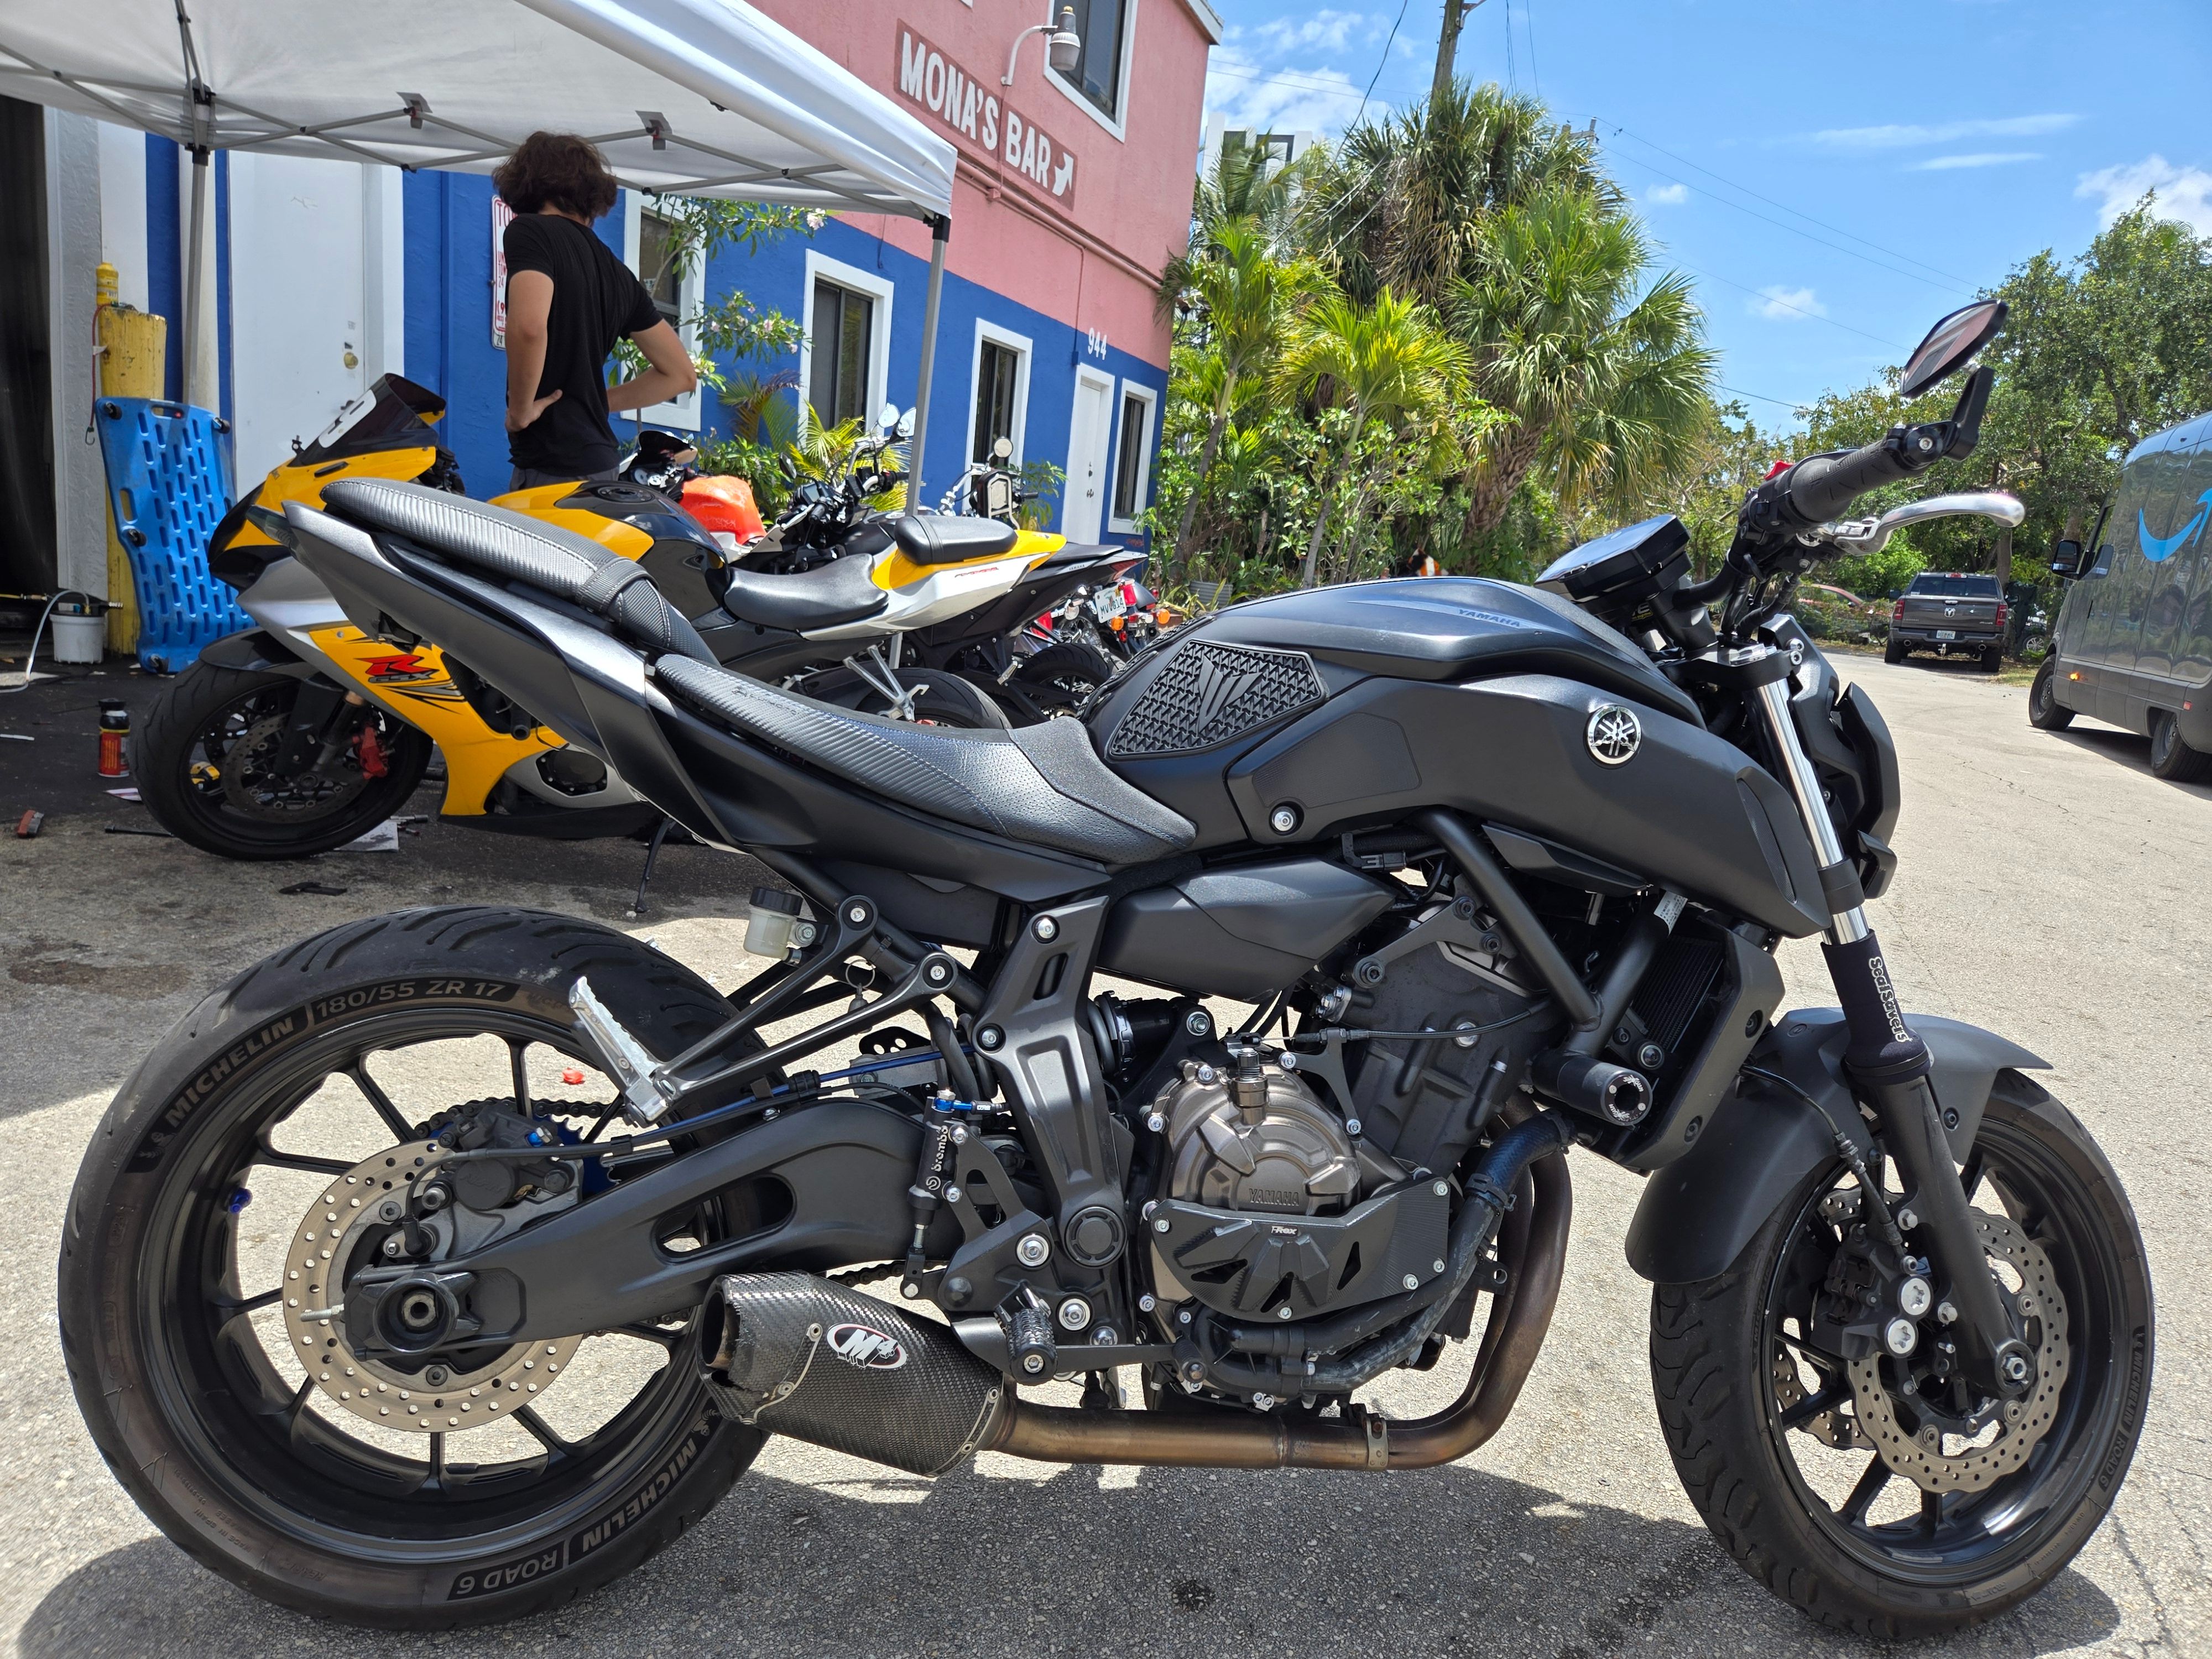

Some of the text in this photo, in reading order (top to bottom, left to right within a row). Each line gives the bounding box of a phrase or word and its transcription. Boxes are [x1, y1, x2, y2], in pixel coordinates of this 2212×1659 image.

[901, 32, 1051, 188] MONA'S BAR
[1088, 327, 1107, 361] 944
[1459, 609, 1520, 627] YAMAHA
[354, 654, 440, 676] R
[368, 674, 432, 684] GSX
[317, 979, 506, 1018] 180/55 ZR 17
[1869, 956, 1910, 1042] SealSavers
[165, 1016, 294, 1129] MICHELIN
[931, 1125, 949, 1172] brembo
[1249, 1188, 1300, 1206] YAMAHA
[2124, 1351, 2143, 1427] MICHELIN
[2104, 1437, 2126, 1475] ROAD
[582, 1439, 699, 1553] MICHELIN
[457, 1549, 557, 1594] ROAD 6
